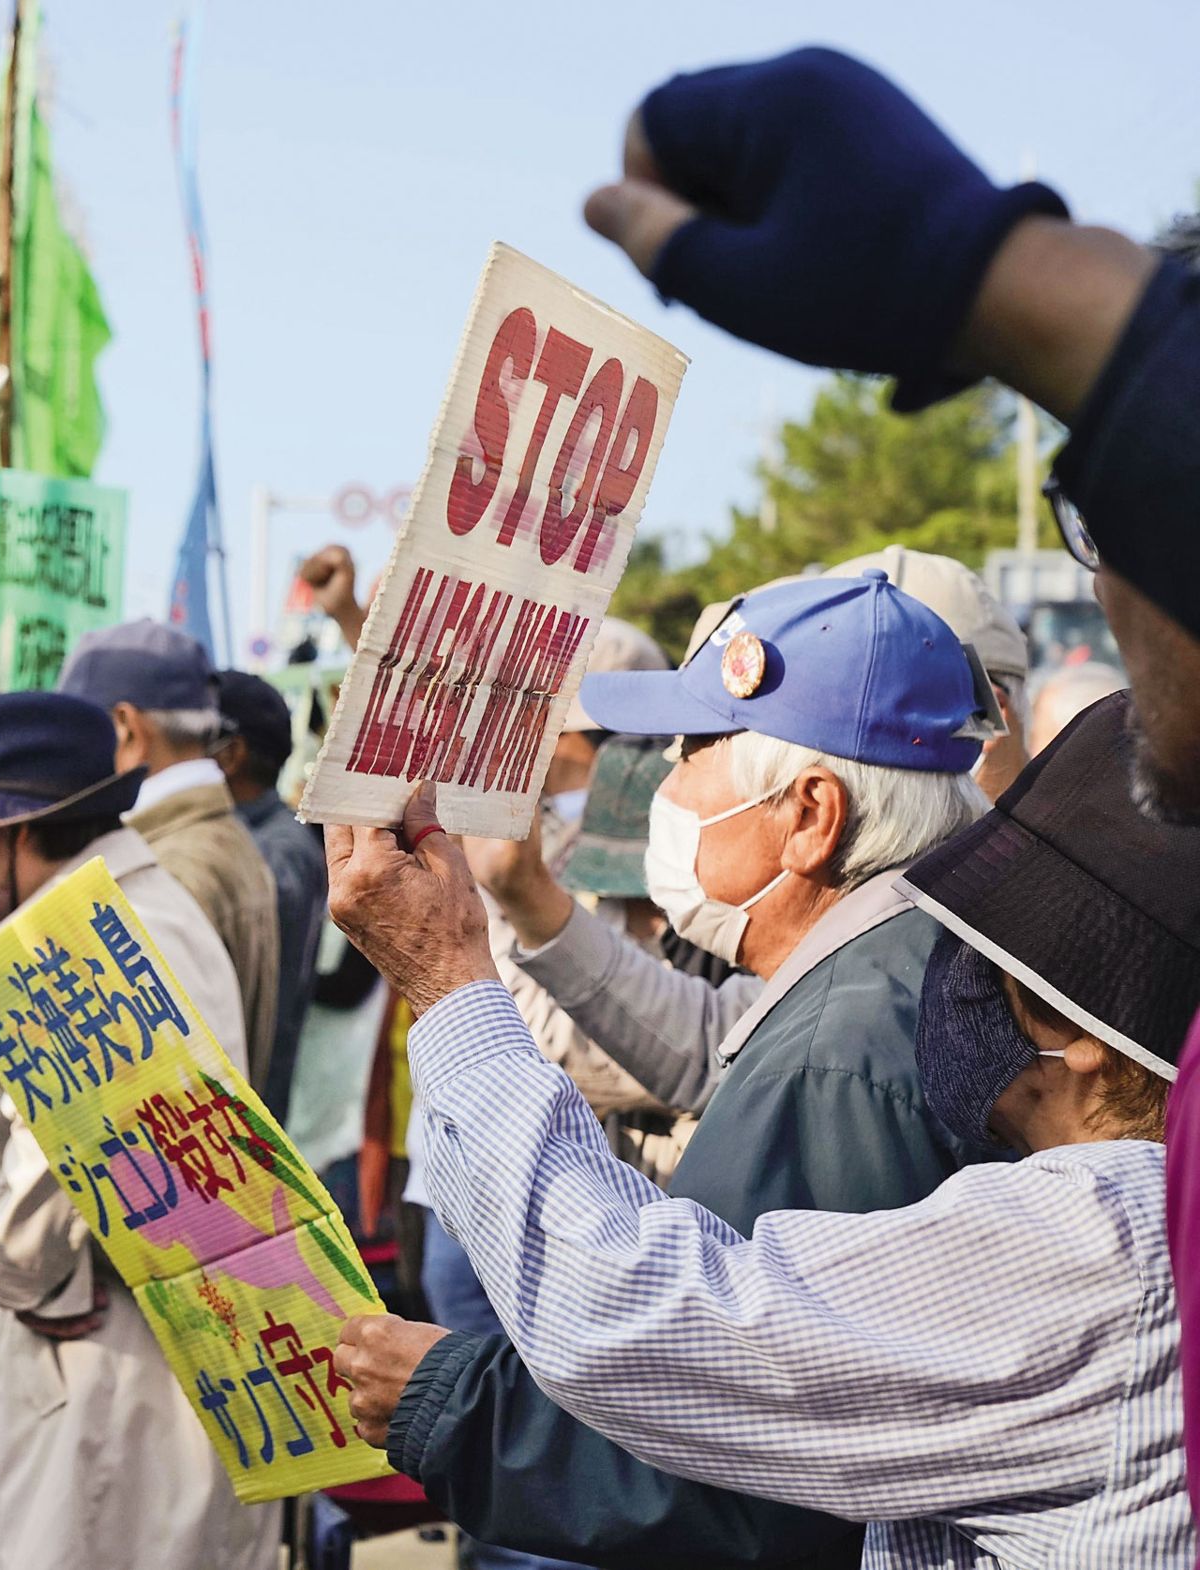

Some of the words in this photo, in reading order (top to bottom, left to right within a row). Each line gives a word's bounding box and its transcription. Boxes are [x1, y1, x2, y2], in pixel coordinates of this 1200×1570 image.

[447, 306, 659, 574] STOP
[345, 566, 514, 784] ILLEGAL
[457, 598, 590, 794] WORK
[58, 1079, 277, 1238] ジュゴン殺すな
